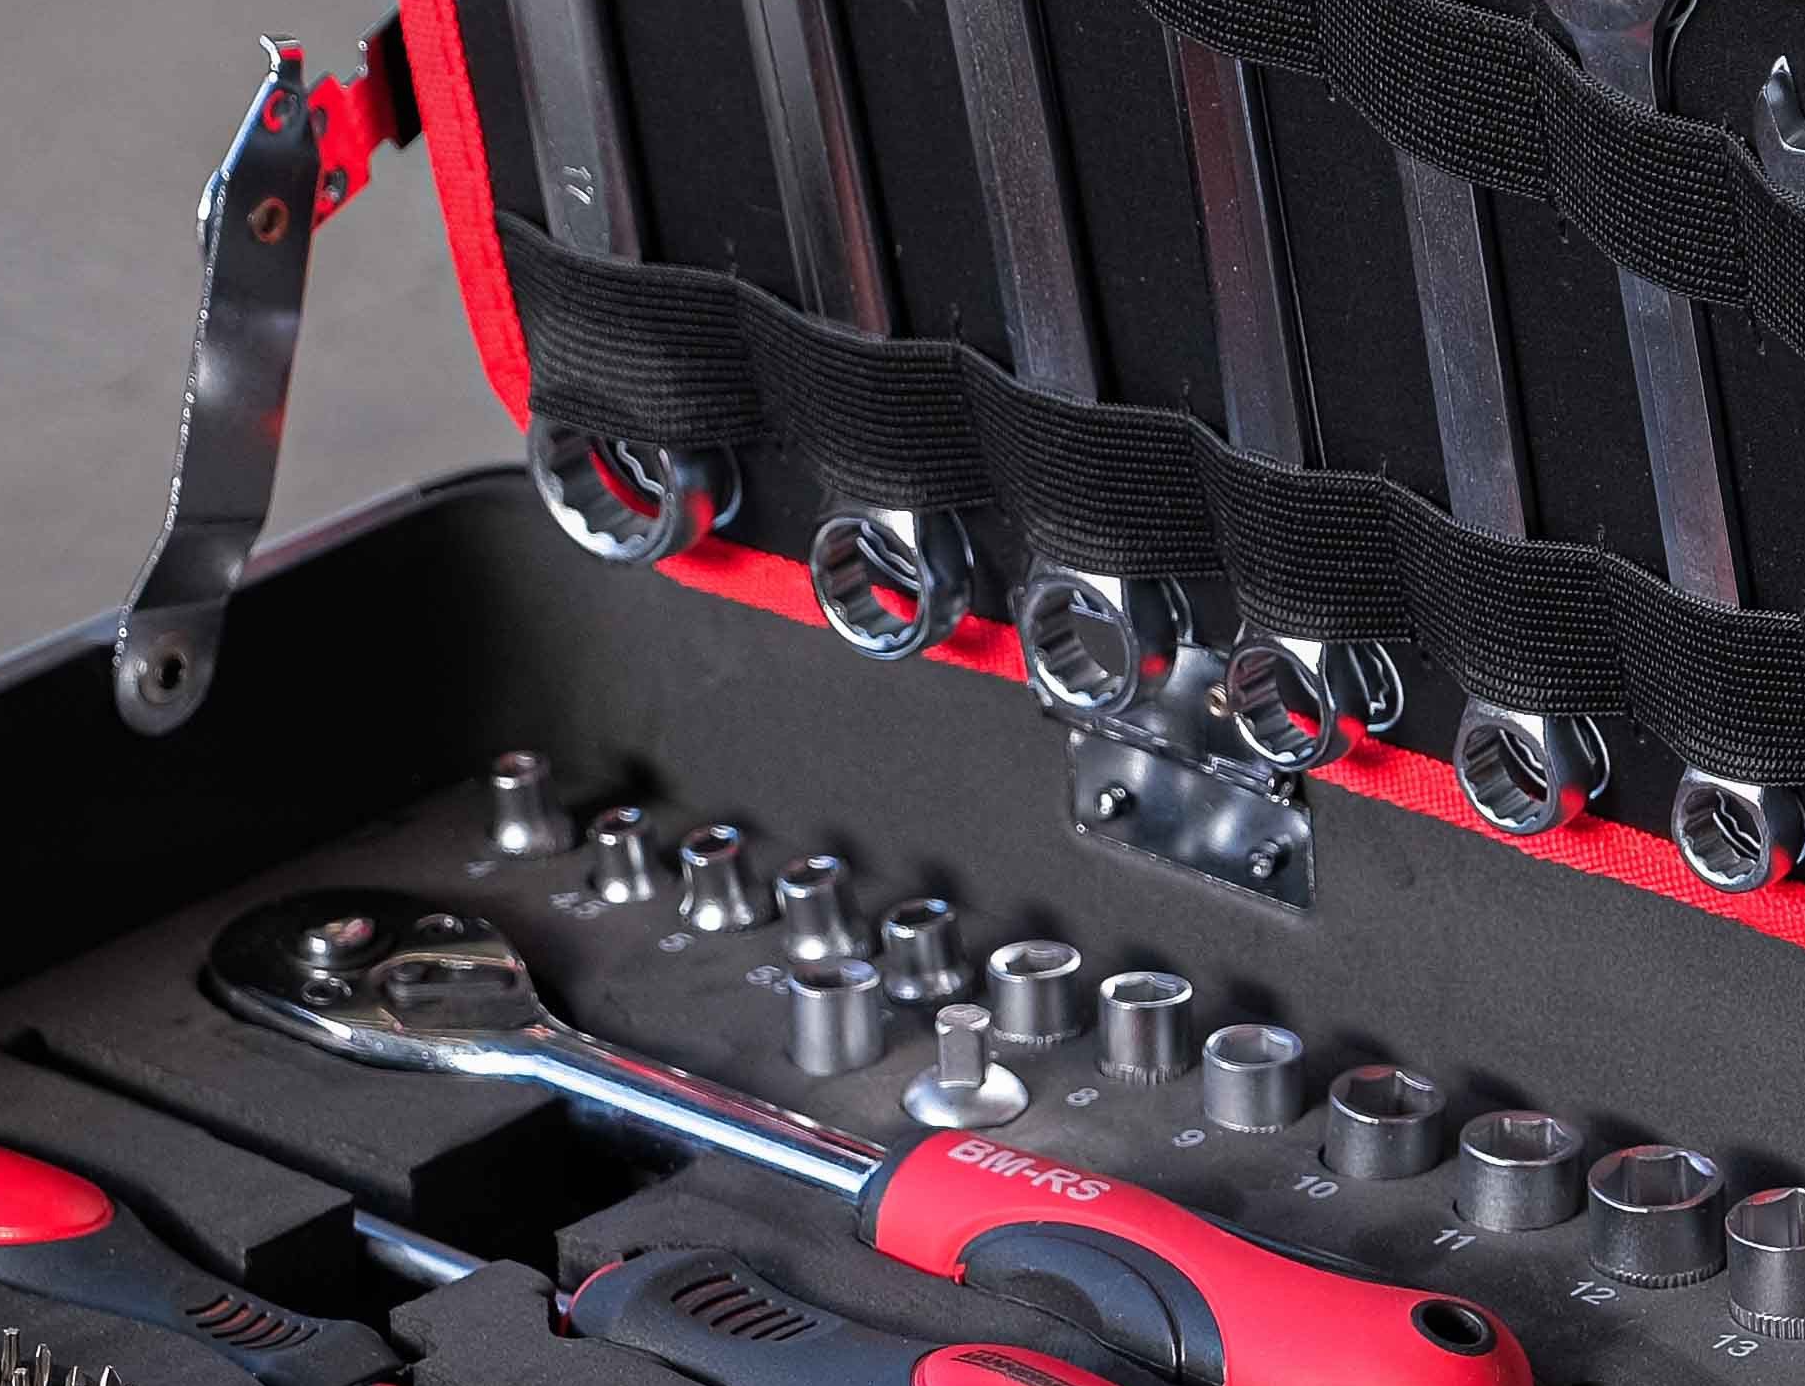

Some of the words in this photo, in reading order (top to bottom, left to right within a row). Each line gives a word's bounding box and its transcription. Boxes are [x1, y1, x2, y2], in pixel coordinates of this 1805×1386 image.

[1065, 1087, 1100, 1108] 8
[1171, 1129, 1207, 1149] 9
[948, 1138, 1111, 1201] BM-RS
[1293, 1175, 1340, 1199] 10
[1432, 1228, 1477, 1251] 11
[1569, 1280, 1618, 1305] 12
[1711, 1332, 1759, 1358] 13
